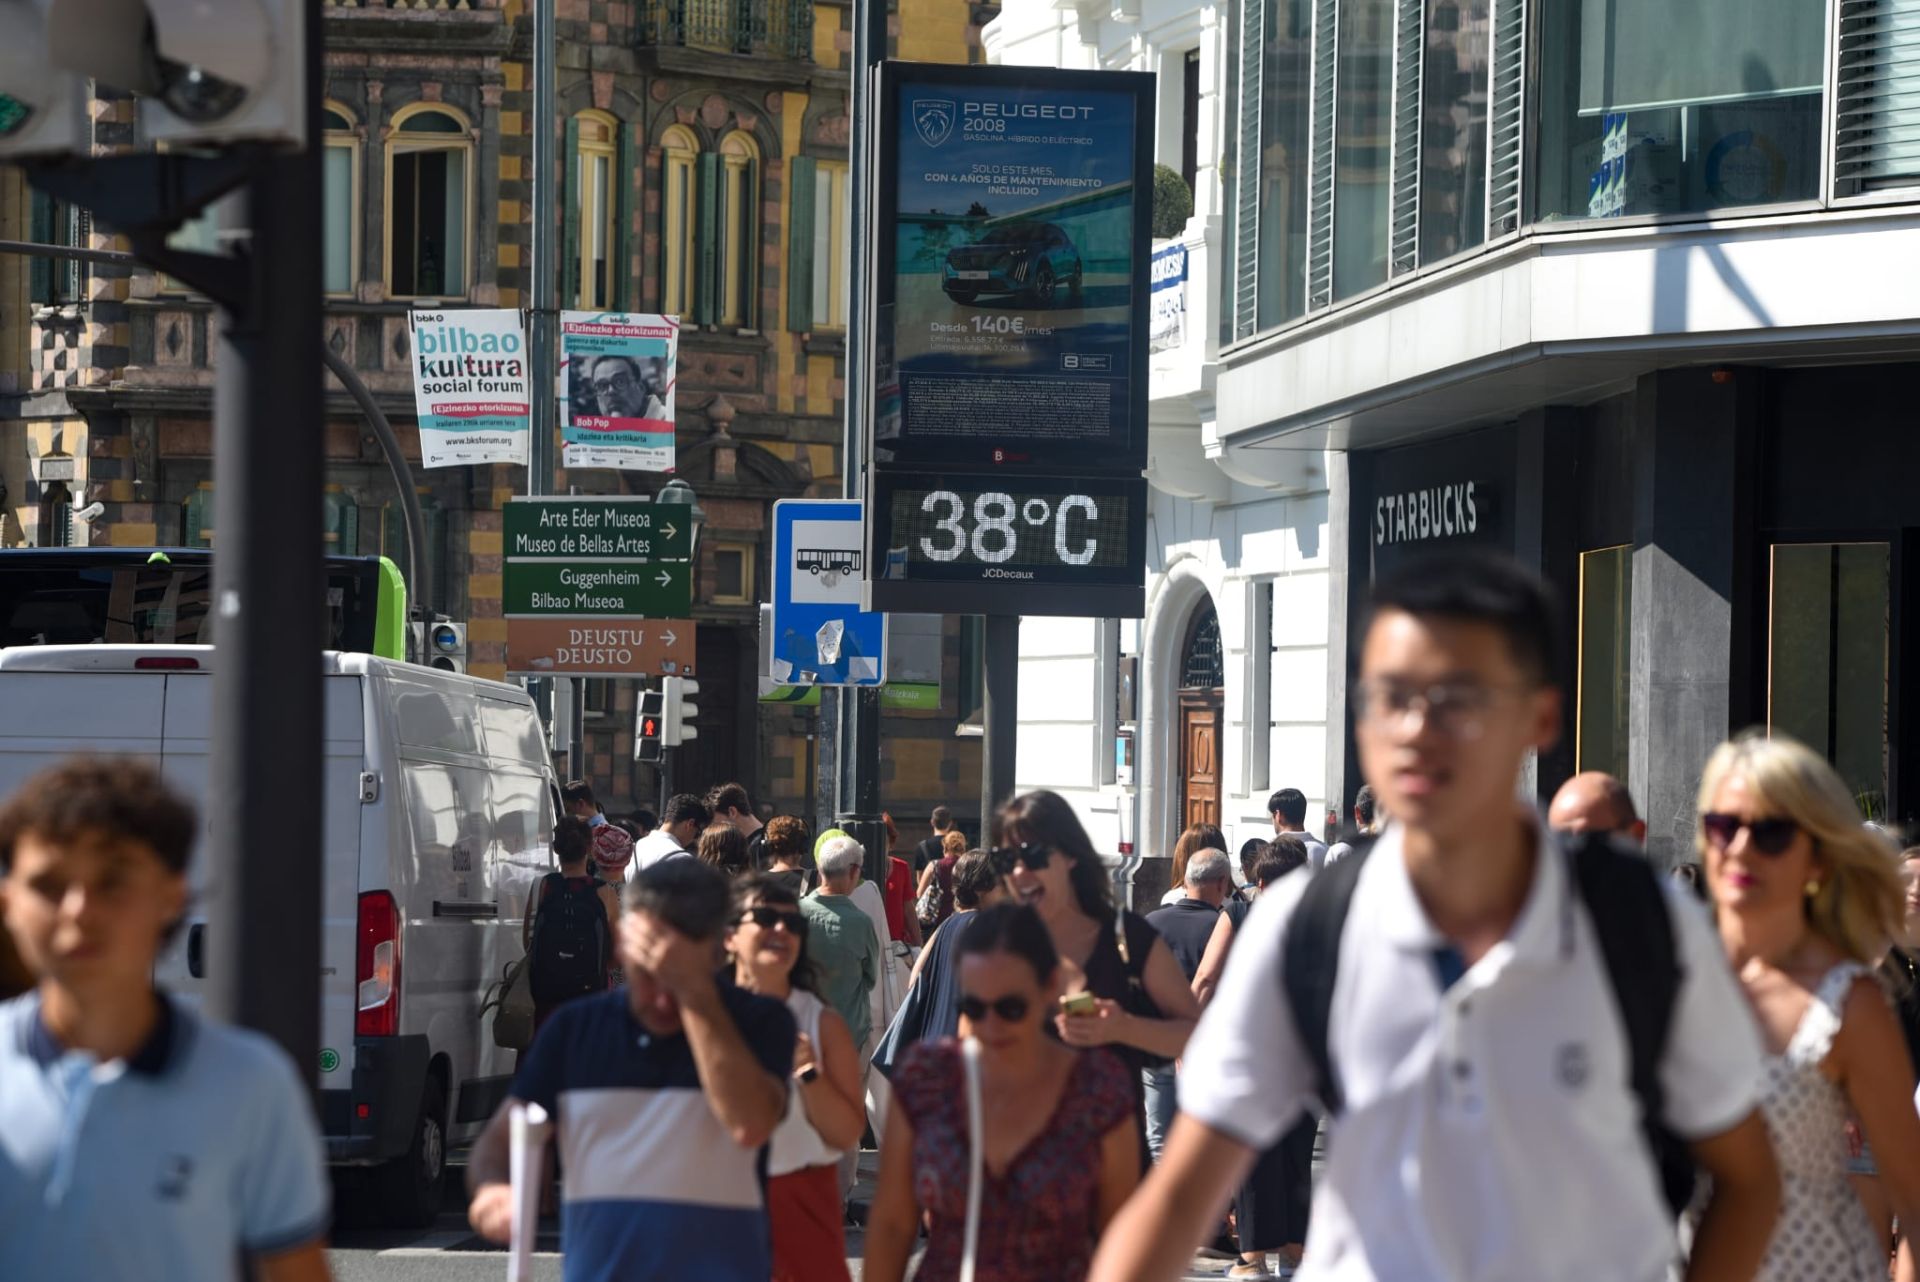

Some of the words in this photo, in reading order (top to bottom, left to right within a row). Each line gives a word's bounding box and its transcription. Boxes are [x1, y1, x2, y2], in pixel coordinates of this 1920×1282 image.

[963, 102, 1095, 120] PEUGEOT
[963, 118, 1006, 133] 2008
[972, 164, 1000, 175] SOLO
[1002, 165, 1029, 176] ESTE
[924, 172, 949, 183] CON
[950, 173, 958, 183] 4
[959, 172, 991, 185] AÑOS
[993, 175, 1008, 185] DE
[1009, 175, 1102, 189] MANTENIMIENTO
[987, 185, 1039, 197] INCLUIDO
[615, 326, 672, 337] etorkizunak
[930, 321, 968, 333] Desde
[416, 326, 520, 354] bilbao
[419, 354, 523, 379] kultura
[423, 378, 473, 395] social
[478, 377, 524, 394] forum
[576, 418, 593, 427] Bob
[593, 418, 610, 429] Pop
[603, 433, 614, 441] eta
[994, 450, 1003, 461] B
[539, 508, 569, 527] Arte
[572, 508, 601, 527] Eder
[604, 508, 651, 528] Museoa
[1376, 480, 1477, 546] STARBUCKS
[516, 533, 556, 553] Museo
[559, 533, 577, 553] de
[579, 533, 614, 553] Bellas
[616, 533, 650, 554] Artes
[559, 569, 640, 590] Guggenheim
[982, 567, 1034, 580] JCDecaux
[531, 592, 571, 609] Bilbao
[574, 593, 625, 609] Museoa
[569, 629, 643, 646] DEUSTU
[557, 647, 631, 664] DEUSTO
